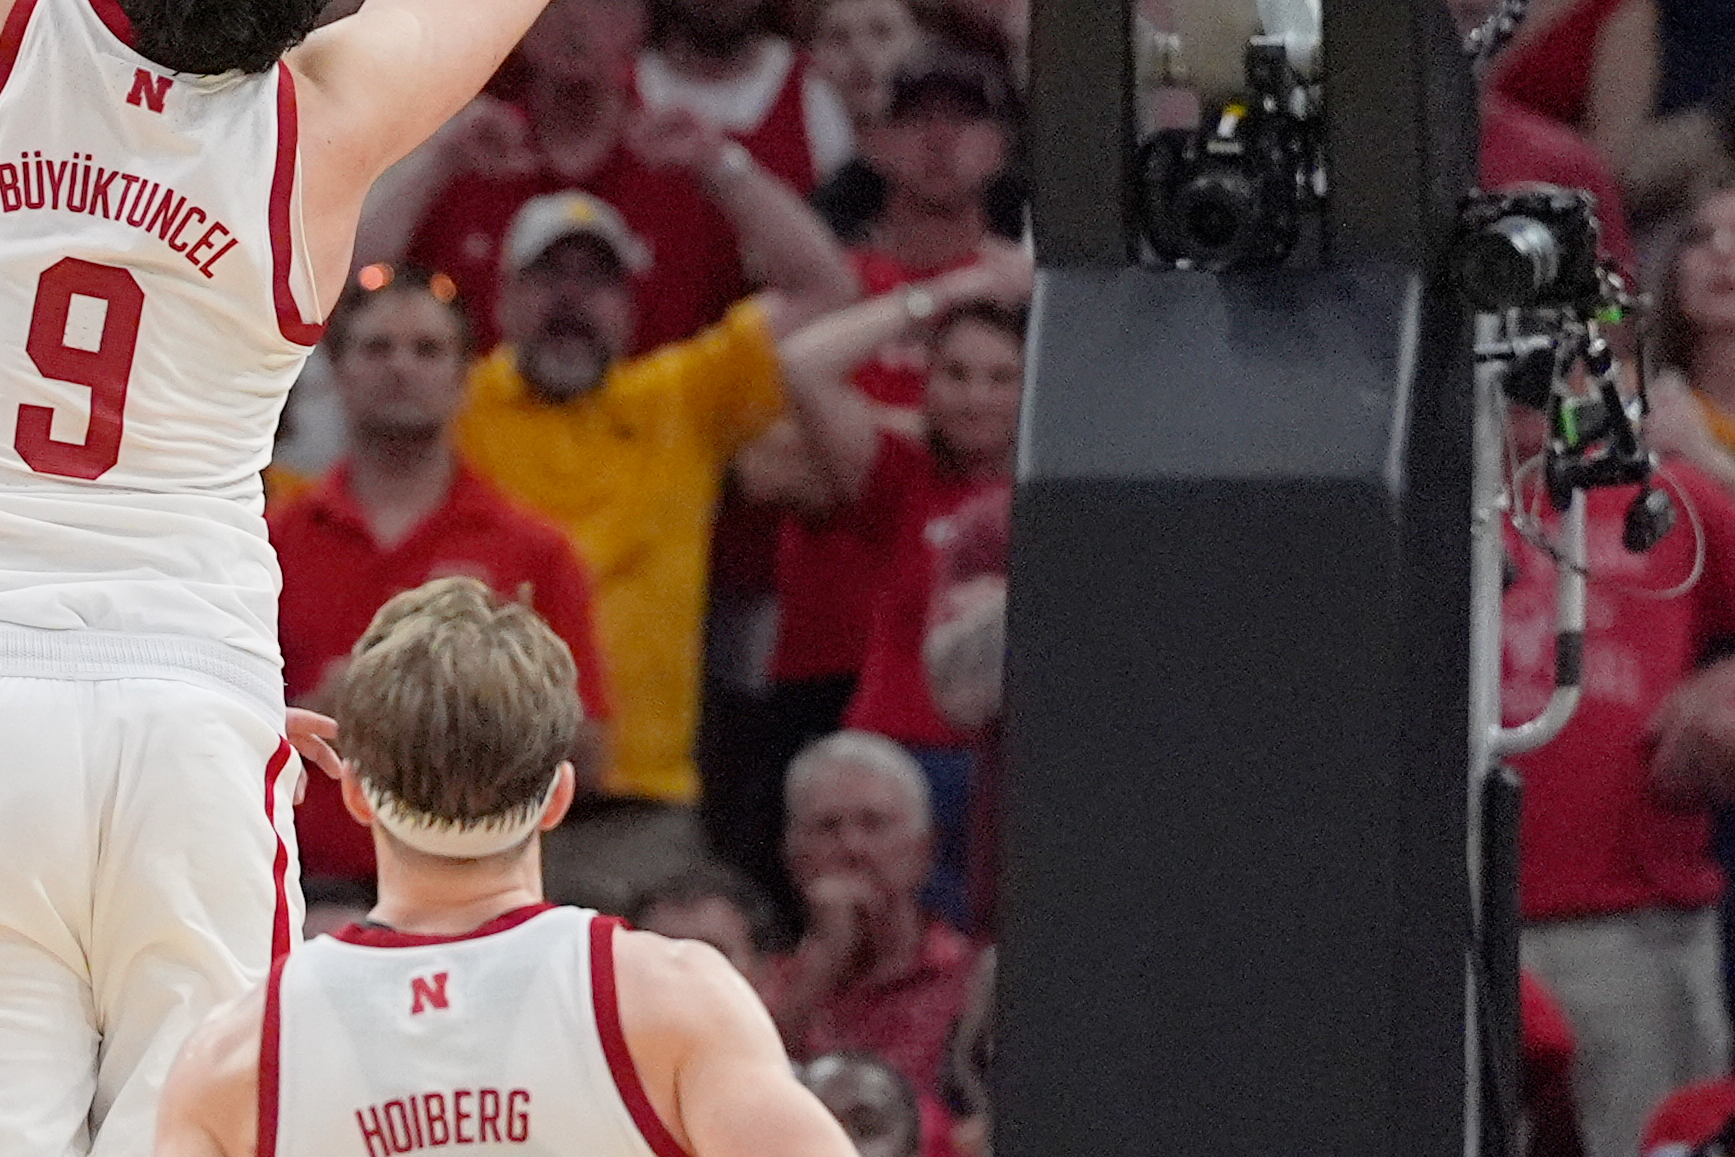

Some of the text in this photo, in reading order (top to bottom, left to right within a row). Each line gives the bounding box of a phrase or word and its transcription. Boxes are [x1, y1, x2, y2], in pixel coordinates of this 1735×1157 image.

[125, 66, 175, 115] N
[13, 255, 145, 481] 9
[411, 972, 450, 1015] N
[355, 1088, 531, 1157] HOIBERG
